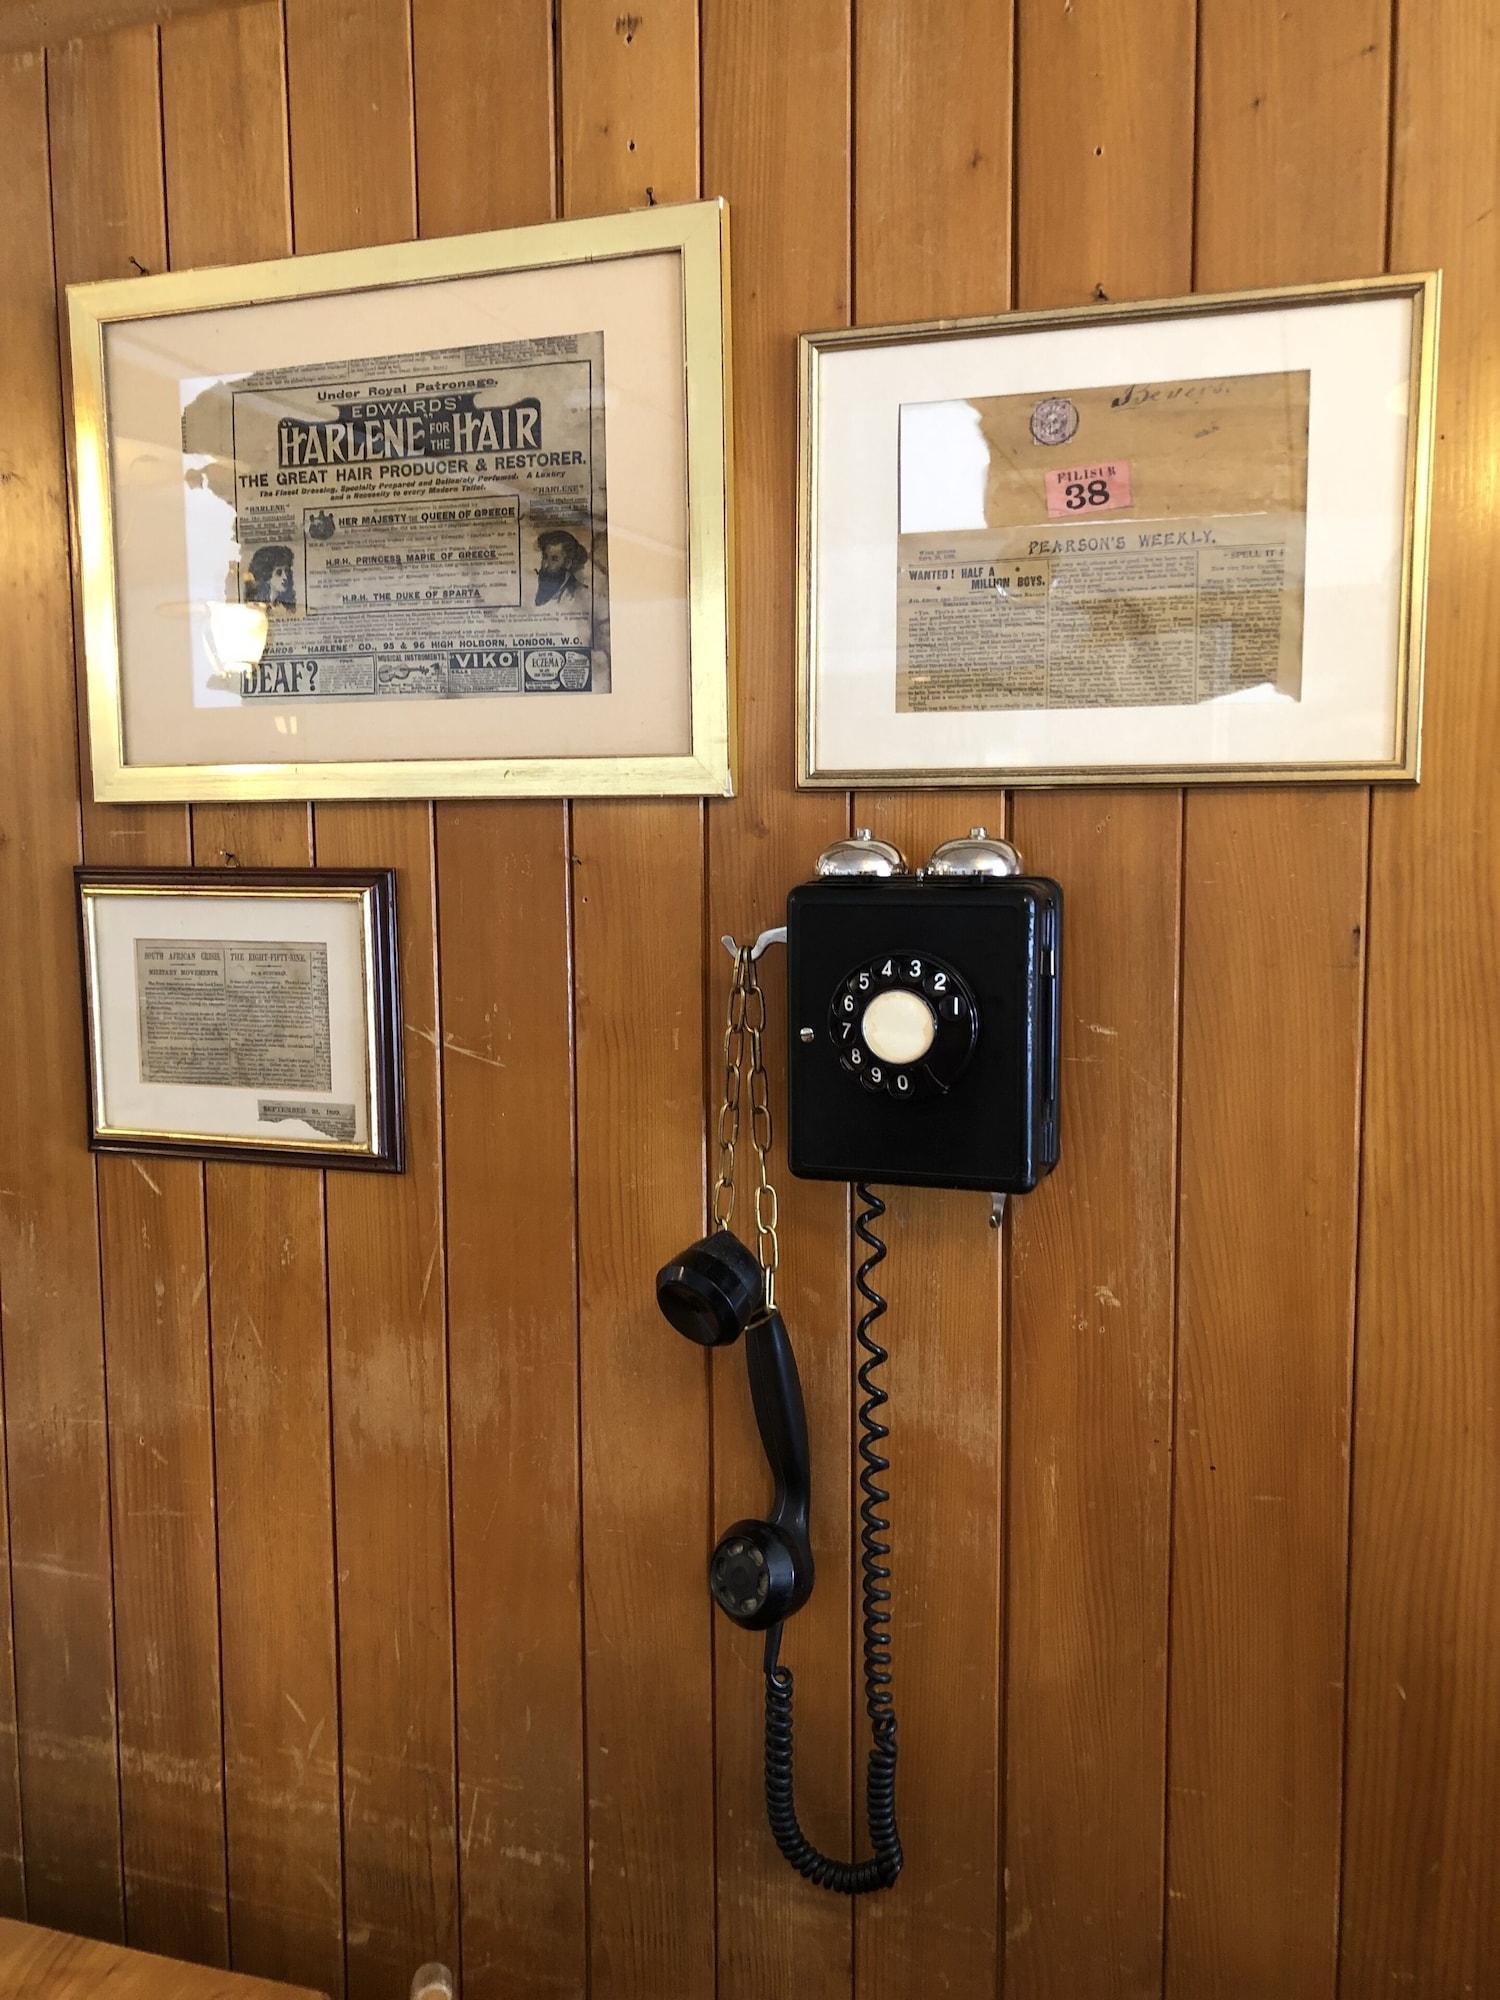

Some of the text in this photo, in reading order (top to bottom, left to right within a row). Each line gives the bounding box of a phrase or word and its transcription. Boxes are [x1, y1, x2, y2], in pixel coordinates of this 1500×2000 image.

[317, 378, 498, 401] Under Royal Patronage.
[430, 421, 450, 434] FOR
[452, 407, 539, 453] HAIR
[430, 439, 451, 451] THE
[238, 451, 586, 488] THE GREAT HAIR PRODUCER & RESTORER.
[1065, 480, 1110, 510] 38
[338, 517, 358, 526] HER
[362, 514, 406, 524] MAJESTY
[421, 511, 456, 522] QUEEN
[458, 510, 471, 519] OF
[474, 507, 515, 517] GREECE
[1028, 529, 1216, 555] PEARSON'S WEEKLY.
[356, 554, 401, 565] PRINCESS
[441, 552, 454, 560] OF
[459, 550, 497, 559] GREECE
[961, 567, 983, 579] HALF
[989, 567, 995, 576] A
[373, 592, 391, 600] THE
[396, 591, 420, 600] DUKE
[443, 589, 481, 598] SPARTA
[413, 641, 425, 649] 96
[431, 640, 454, 648] HIGH
[882, 960, 892, 976] 4
[910, 960, 921, 977] 3
[859, 972, 869, 990] 5
[934, 973, 946, 991] 2
[844, 995, 853, 1012] 6
[954, 997, 958, 1015] 1
[842, 1023, 851, 1039] 7
[851, 1049, 861, 1064] 8
[871, 1067, 881, 1083] 9
[897, 1075, 908, 1090] 0
